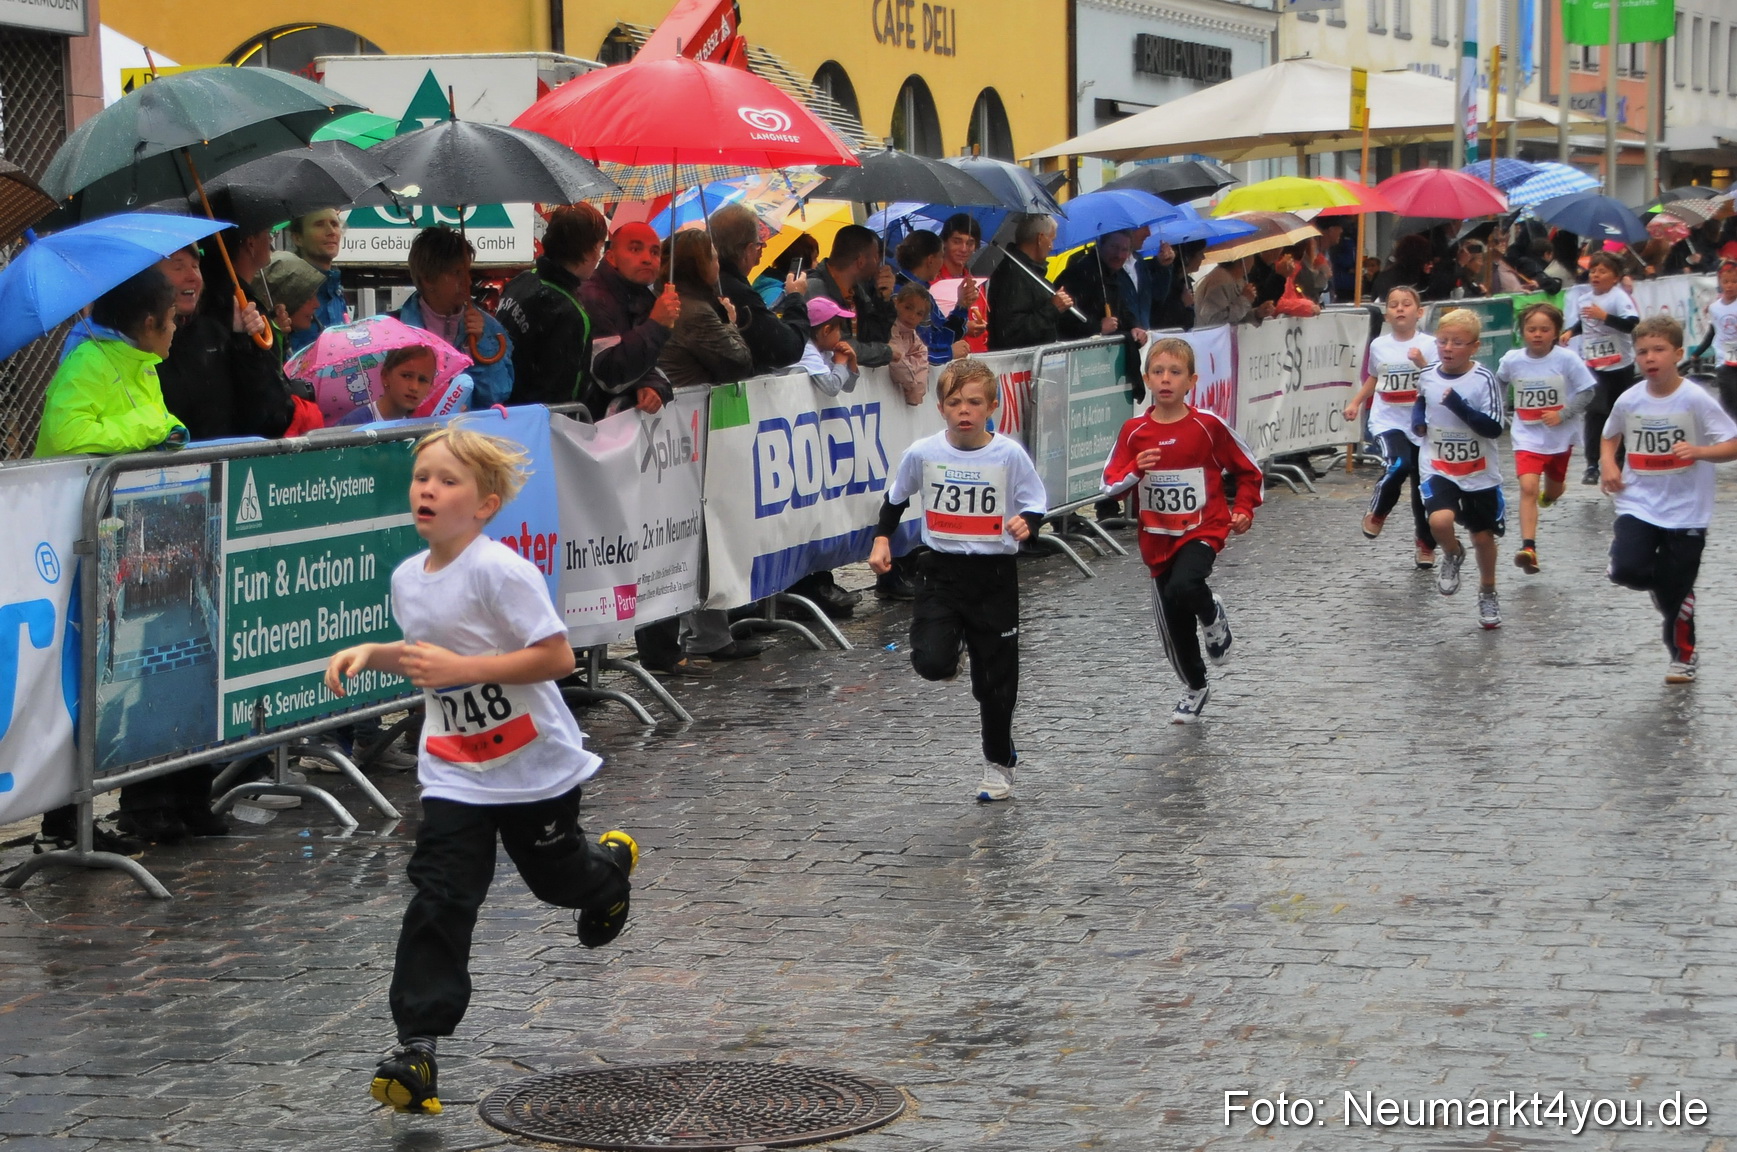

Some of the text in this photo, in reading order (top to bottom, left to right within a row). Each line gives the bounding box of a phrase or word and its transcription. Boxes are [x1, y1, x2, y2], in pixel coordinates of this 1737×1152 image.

[922, 3, 956, 57] DELI
[750, 132, 800, 143] LANGNESE
[342, 237, 366, 251] Jura
[371, 236, 412, 250] Gebäu
[477, 237, 515, 250] GmbH
[1249, 352, 1281, 381] RECHTS
[1307, 340, 1356, 370] ANWÄLTE
[1382, 372, 1420, 391] 7075
[1517, 389, 1558, 407] 7299
[641, 410, 699, 484] Xplus1
[1434, 440, 1480, 461] 7359
[1633, 429, 1685, 453] 7058
[753, 402, 889, 519] BOCK
[945, 470, 981, 480] BOCK
[268, 476, 375, 507] Event-Leit-Systeme
[931, 483, 996, 514] 7316
[1144, 486, 1197, 512] 7336
[642, 523, 654, 550] 2x
[656, 519, 664, 545] in
[566, 540, 587, 571] Ihr
[234, 545, 375, 605] Fun & Action in
[232, 594, 389, 662] sicheren Bahnen!
[232, 699, 257, 726] Mie
[262, 694, 273, 718] &
[276, 686, 315, 715] Service
[346, 670, 377, 697] 09181
